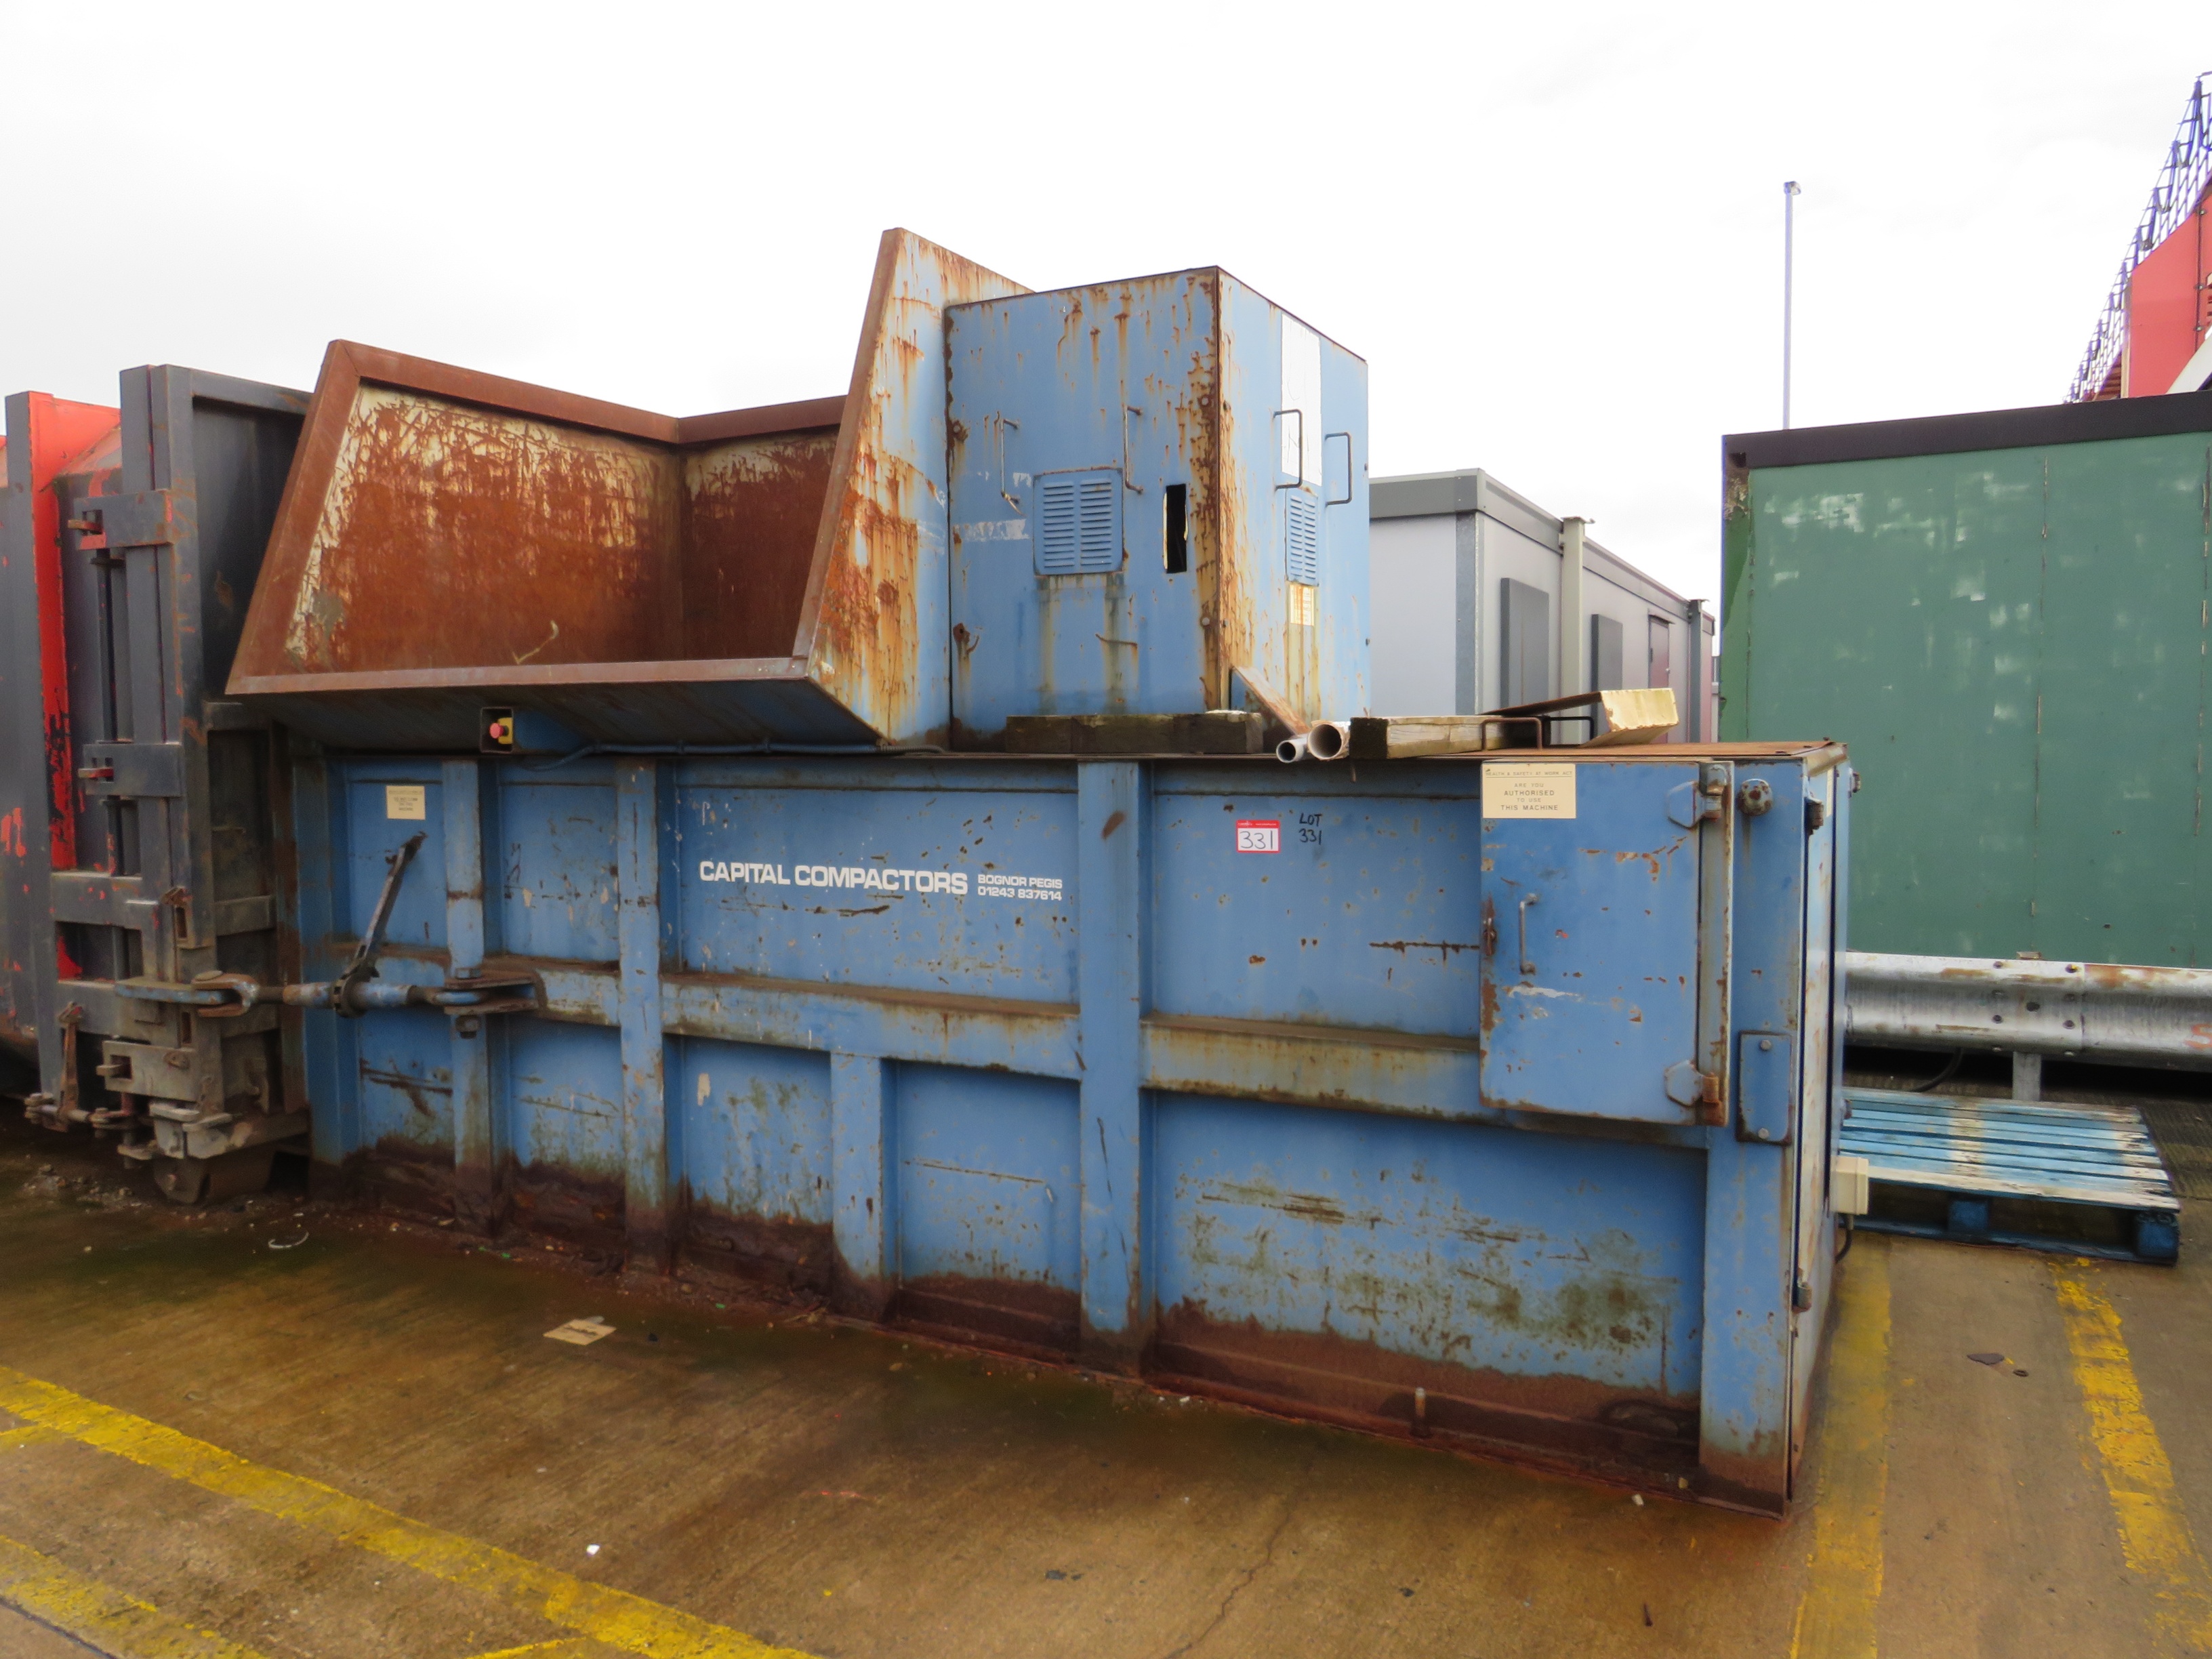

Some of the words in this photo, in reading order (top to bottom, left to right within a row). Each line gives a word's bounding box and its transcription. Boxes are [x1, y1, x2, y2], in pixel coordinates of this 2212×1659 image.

[1298, 813, 1323, 827] LOT
[1239, 830, 1273, 850] 331
[1298, 828, 1323, 845] 331
[699, 861, 791, 885] CAPITAL
[794, 865, 968, 895] COMPACTORS
[977, 874, 1027, 886] BOGNOR
[977, 886, 1015, 898] 01243
[1017, 888, 1063, 901] 837614
